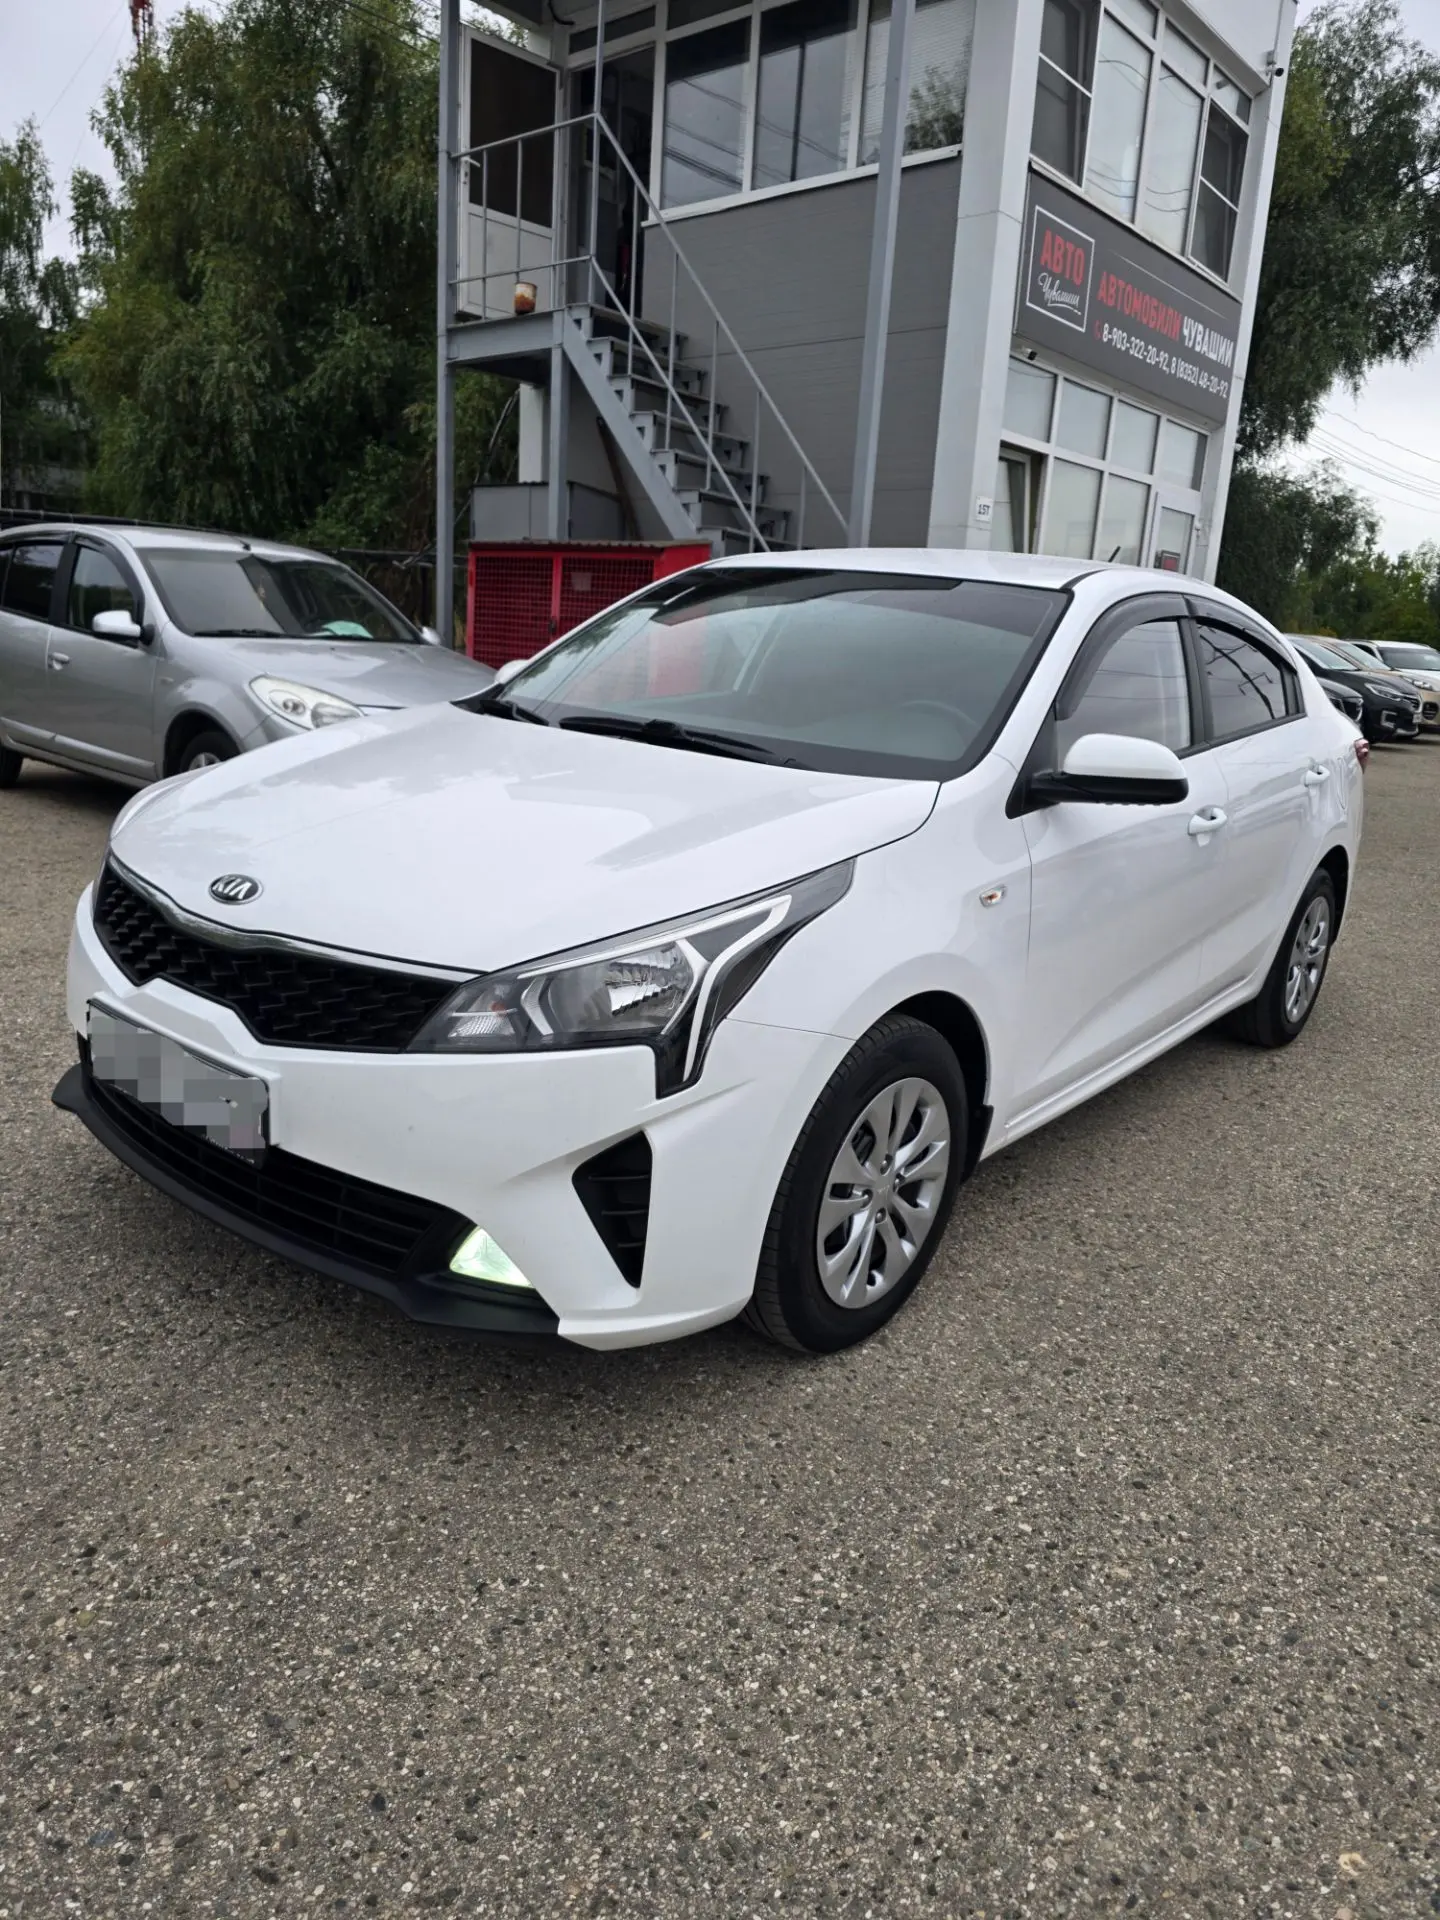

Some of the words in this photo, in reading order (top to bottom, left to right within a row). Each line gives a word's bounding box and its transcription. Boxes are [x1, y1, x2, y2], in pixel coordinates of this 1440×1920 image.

[1040, 230, 1085, 286] АВТО
[1097, 271, 1182, 342] АВТОМОБИЛИ
[1183, 316, 1234, 368] ЧУВАШИИ
[1102, 323, 1170, 374] 8-903-322-20-92,
[1170, 357, 1177, 374] 8
